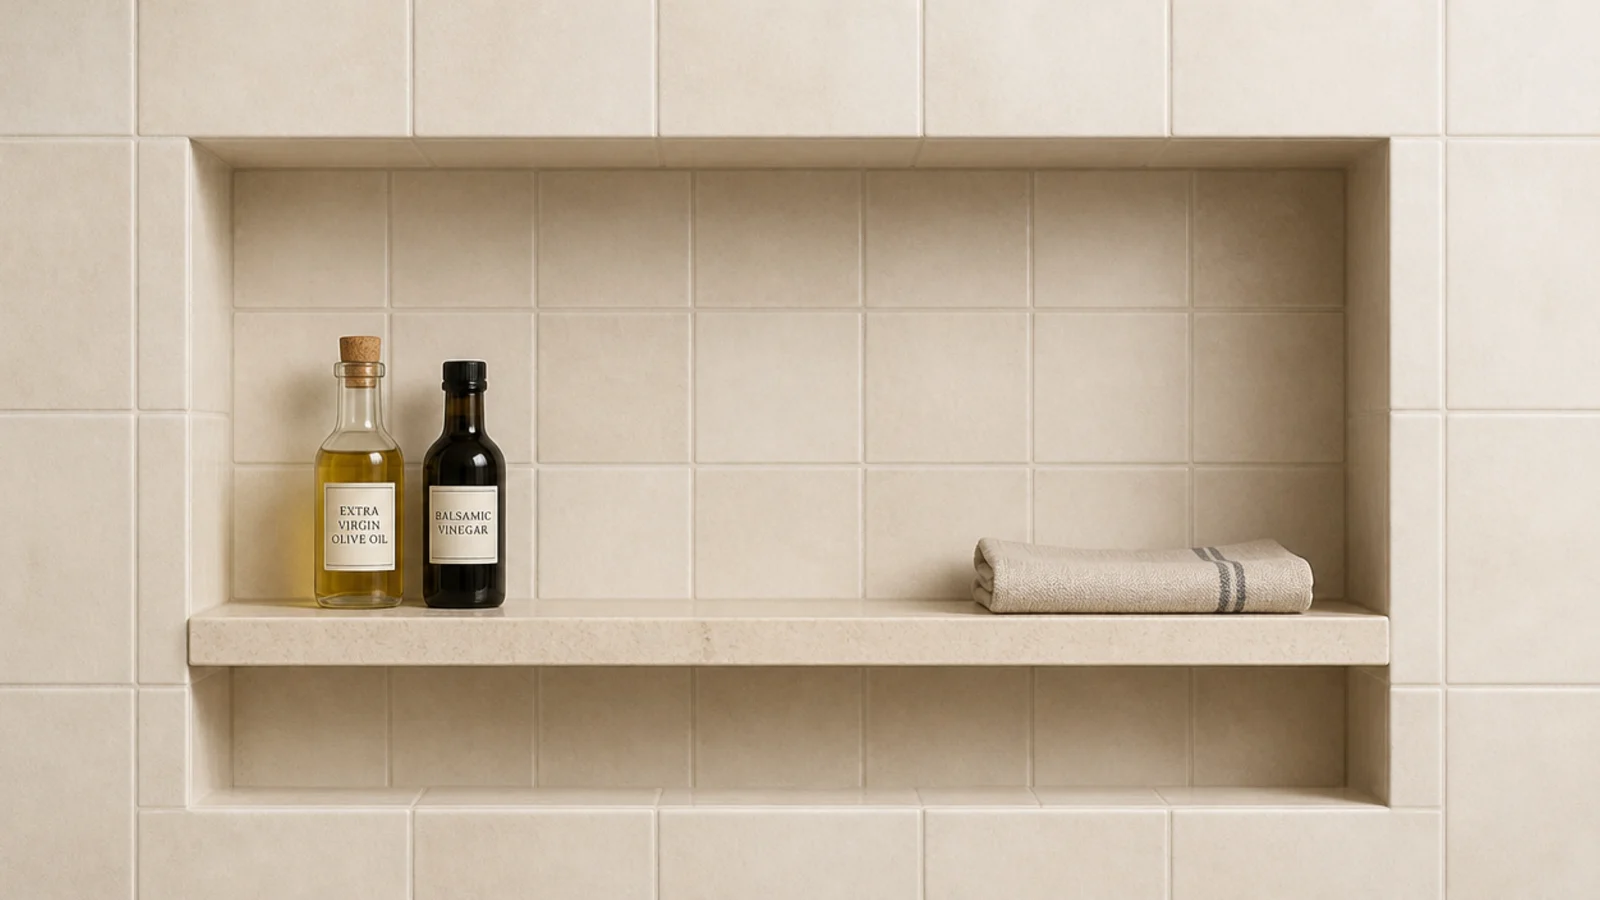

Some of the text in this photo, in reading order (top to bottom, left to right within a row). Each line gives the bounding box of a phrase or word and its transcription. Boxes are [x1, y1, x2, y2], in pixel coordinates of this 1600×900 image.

[339, 505, 379, 516] EXTRA
[435, 510, 492, 521] BALSAMIC
[337, 520, 381, 531] VIRGIN
[438, 524, 489, 535] VINEGAR
[331, 534, 388, 544] OLIVE OIL
